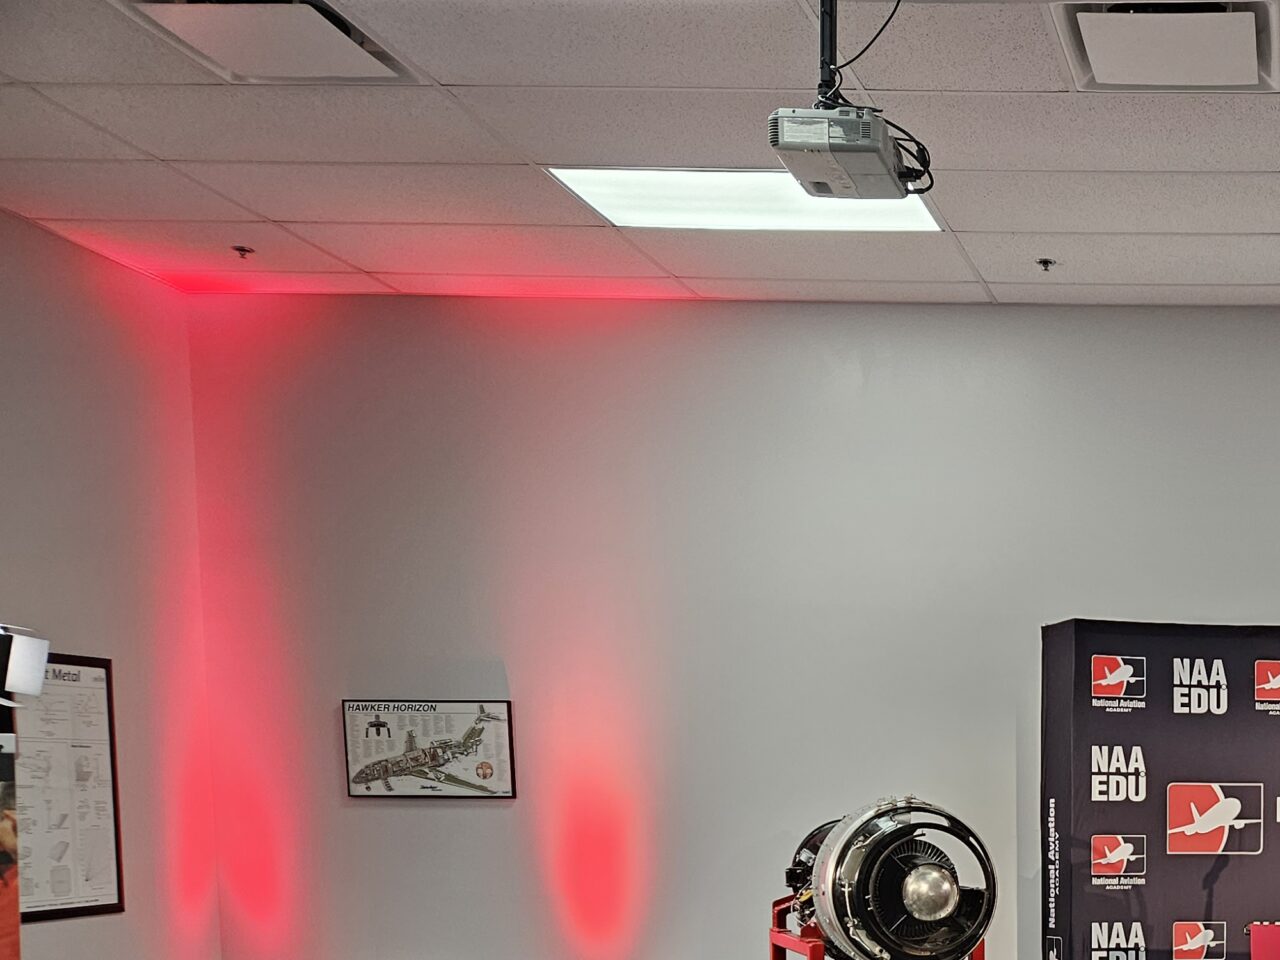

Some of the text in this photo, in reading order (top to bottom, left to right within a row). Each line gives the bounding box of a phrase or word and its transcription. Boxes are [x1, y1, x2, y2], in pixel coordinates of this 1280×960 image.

[52, 668, 80, 682] Metal
[1173, 658, 1227, 686] NAA
[348, 704, 436, 712] HAWKER HORIZON
[1092, 698, 1146, 708] National Aviation
[1173, 686, 1228, 714] EDU
[1255, 702, 1280, 710] National
[1092, 746, 1146, 772] NAA
[1092, 774, 1146, 802] EDU
[1092, 876, 1146, 885] National Aviation
[1092, 922, 1146, 949] NAA
